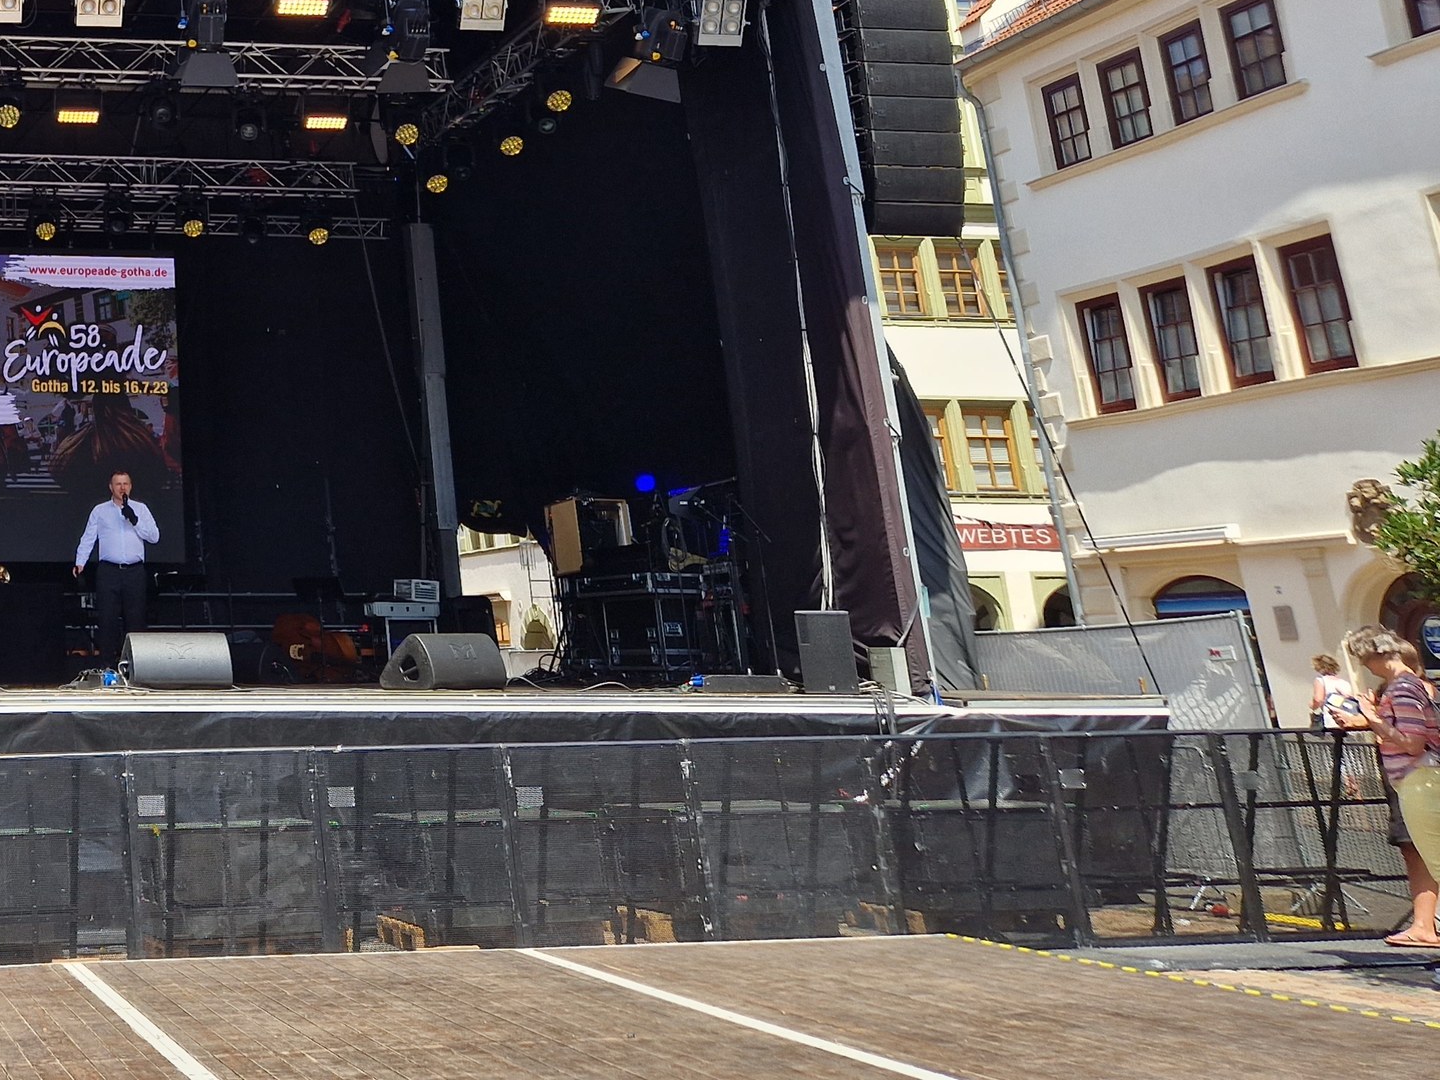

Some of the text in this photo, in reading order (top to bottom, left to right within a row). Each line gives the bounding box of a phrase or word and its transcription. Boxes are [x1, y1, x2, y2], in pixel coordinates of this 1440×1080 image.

[28, 265, 168, 279] www.europeade-gotha.de
[68, 324, 107, 348] 58.
[3, 324, 167, 393] Europeade
[31, 379, 169, 394] Gotha 12. bis 16.7.23
